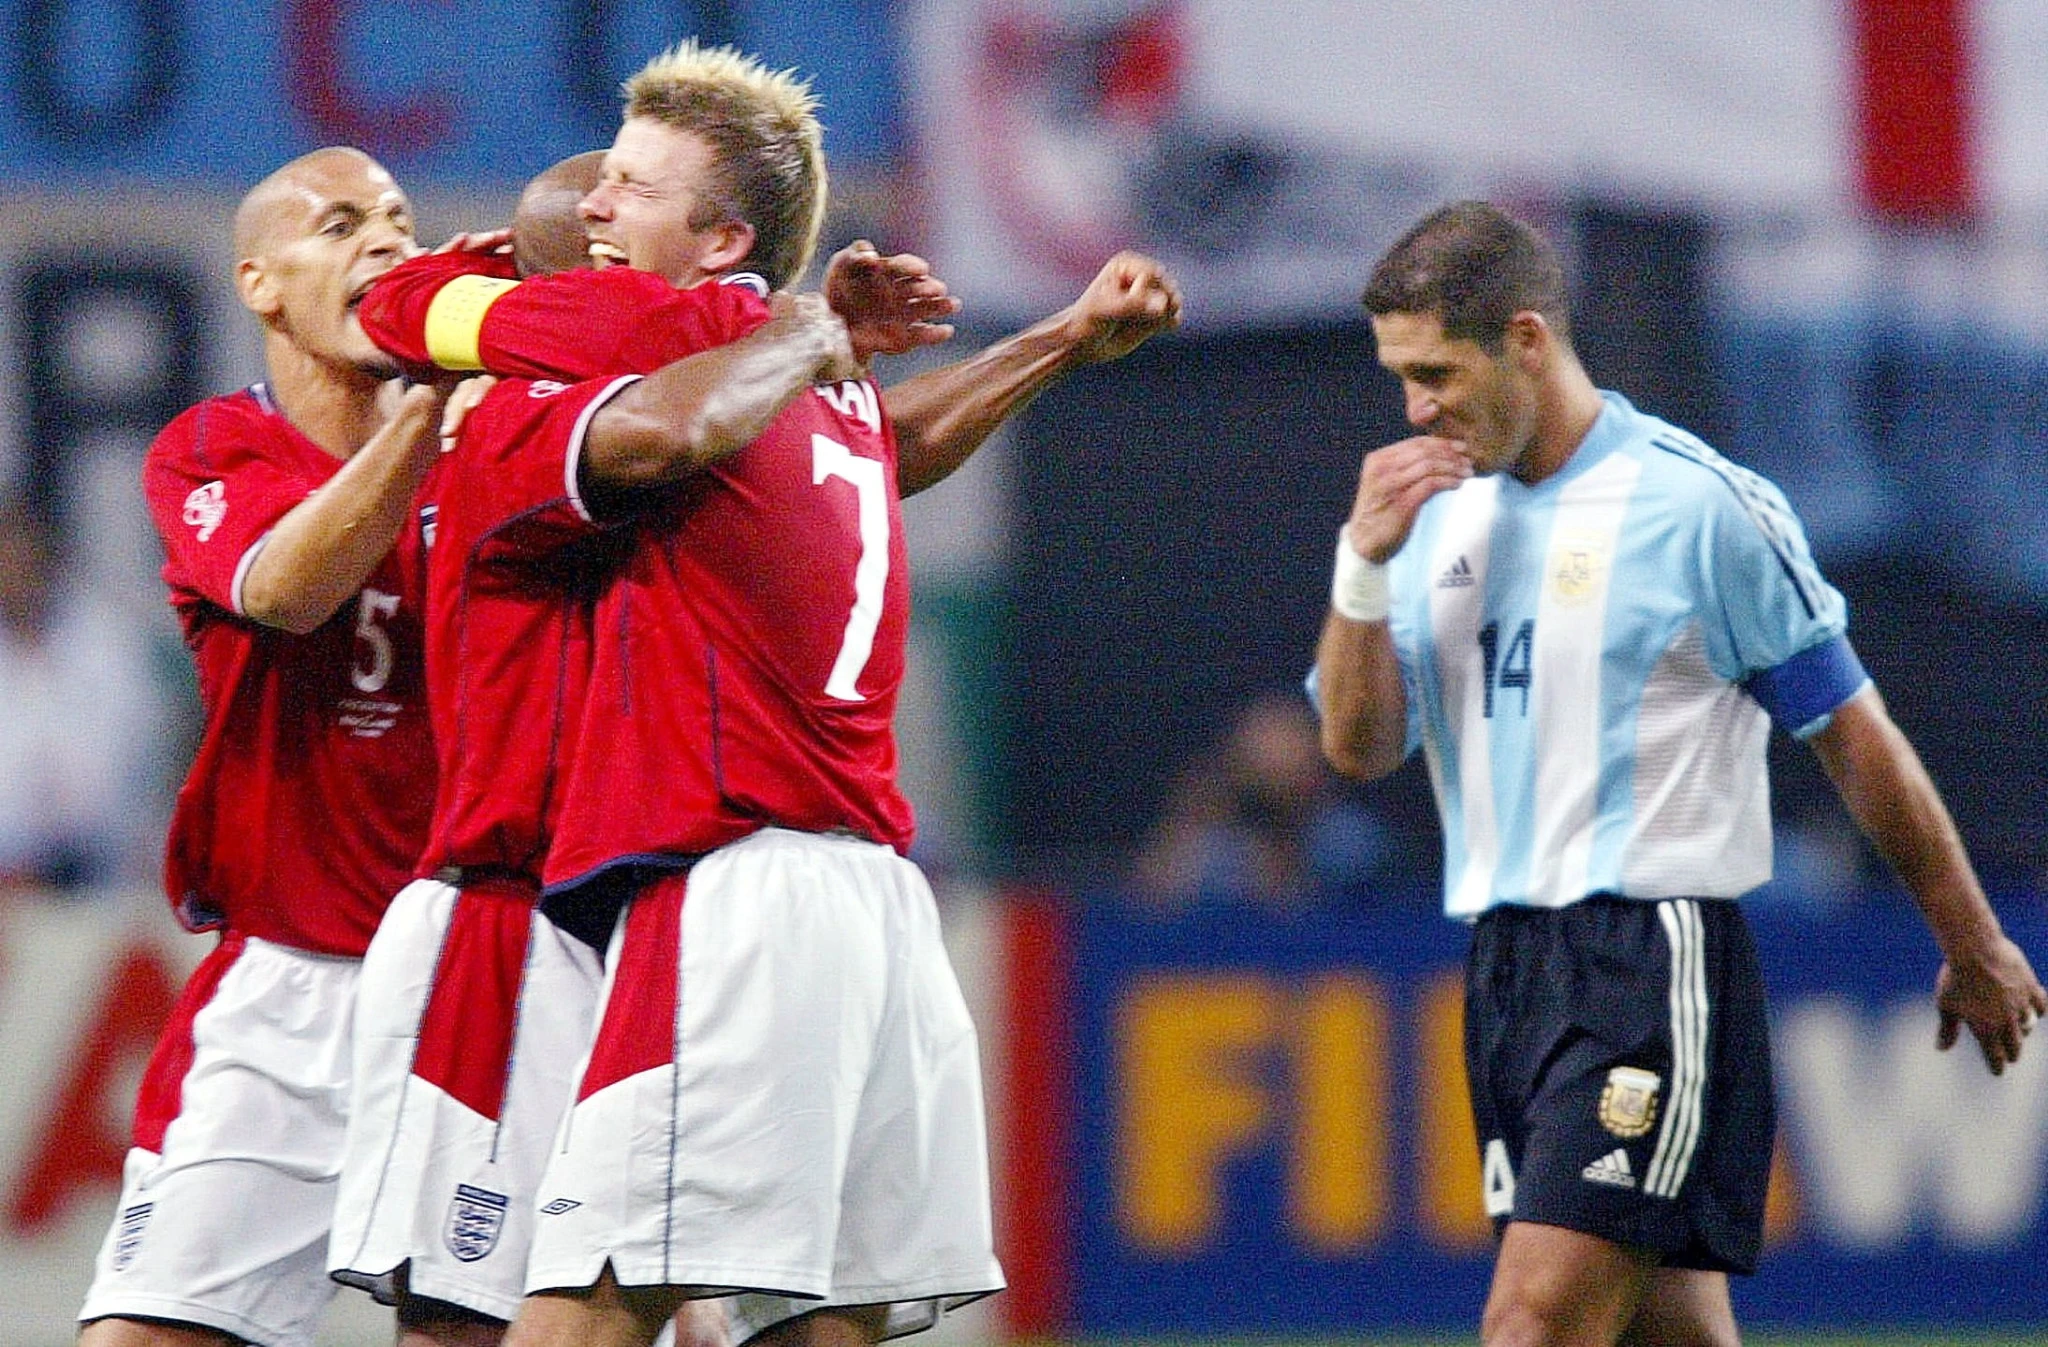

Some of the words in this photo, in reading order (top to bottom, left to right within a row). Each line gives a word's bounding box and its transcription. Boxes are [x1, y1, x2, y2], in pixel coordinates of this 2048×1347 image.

[811, 432, 890, 701] 7
[351, 588, 402, 693] 5
[1477, 618, 1536, 718] 14
